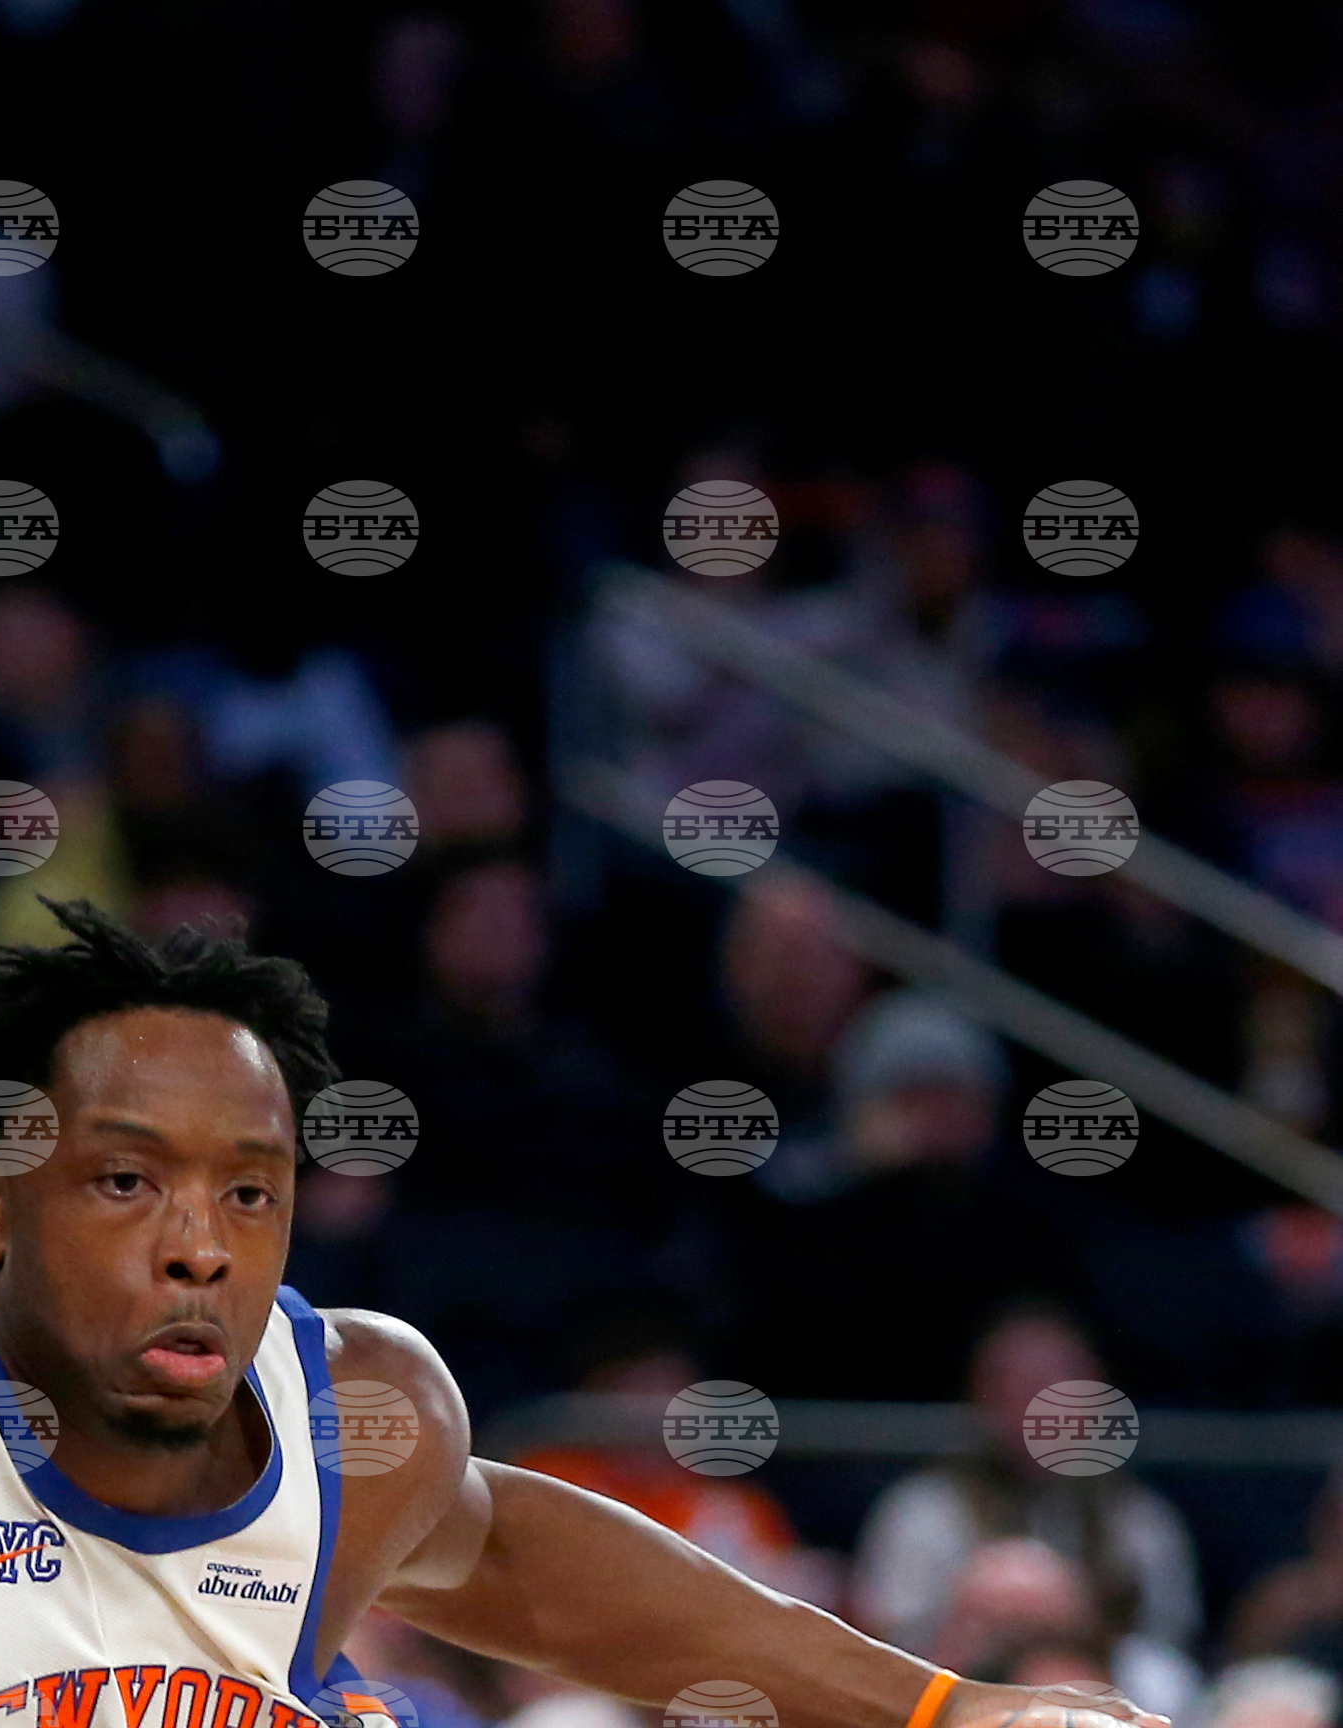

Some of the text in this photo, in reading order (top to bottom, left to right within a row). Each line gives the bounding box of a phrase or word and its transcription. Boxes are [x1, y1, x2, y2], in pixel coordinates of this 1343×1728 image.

[207, 1562, 262, 1577] experience
[198, 1574, 302, 1604] abu dhabi
